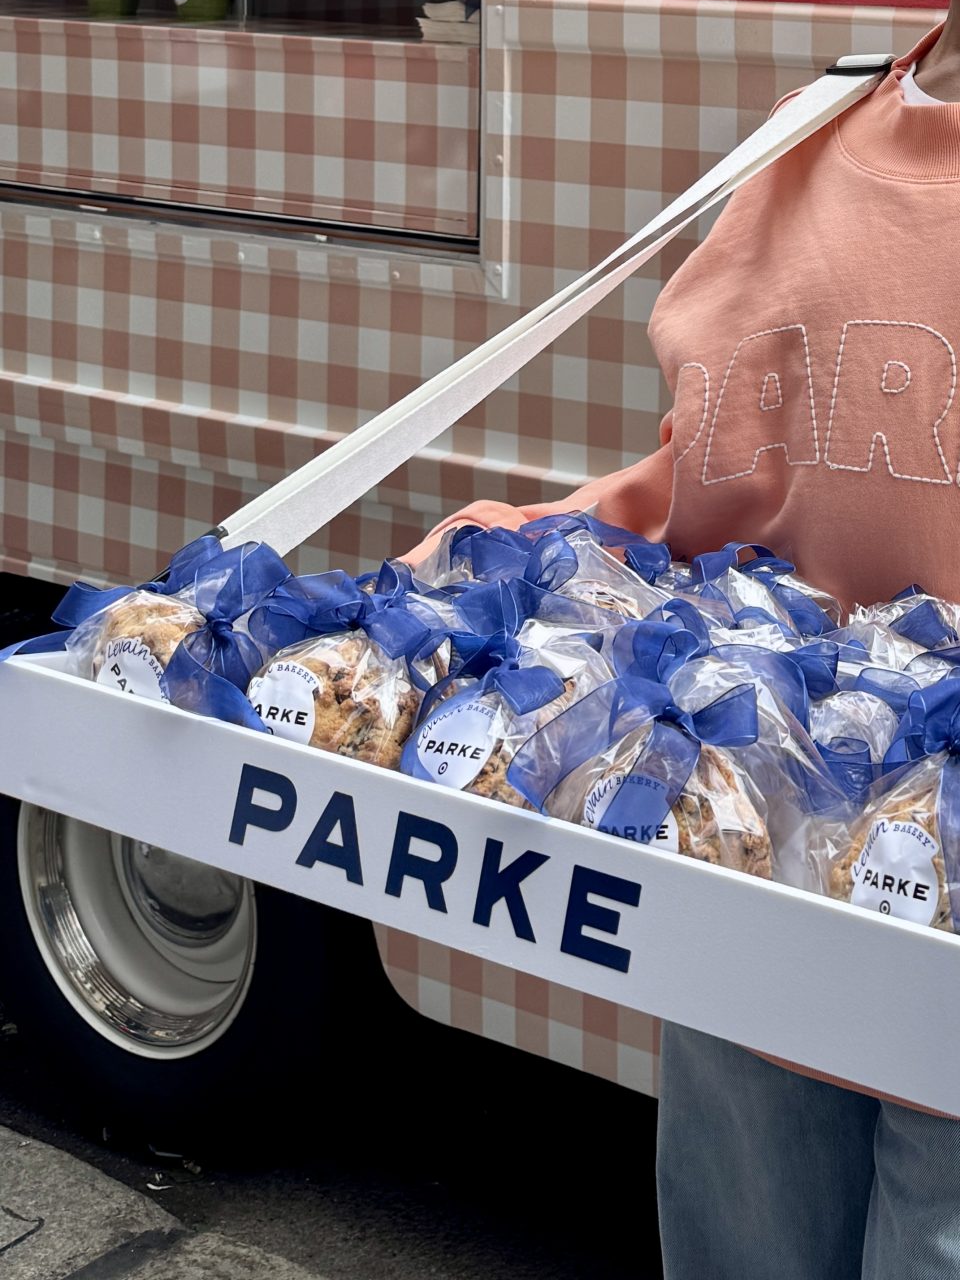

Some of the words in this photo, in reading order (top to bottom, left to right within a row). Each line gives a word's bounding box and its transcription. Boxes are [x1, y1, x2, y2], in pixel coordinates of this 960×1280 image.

[107, 639, 148, 661] Levain
[252, 702, 309, 726] ARKE
[424, 740, 486, 760] PARKE
[228, 763, 643, 974] PARKE
[862, 869, 931, 902] PARKE
